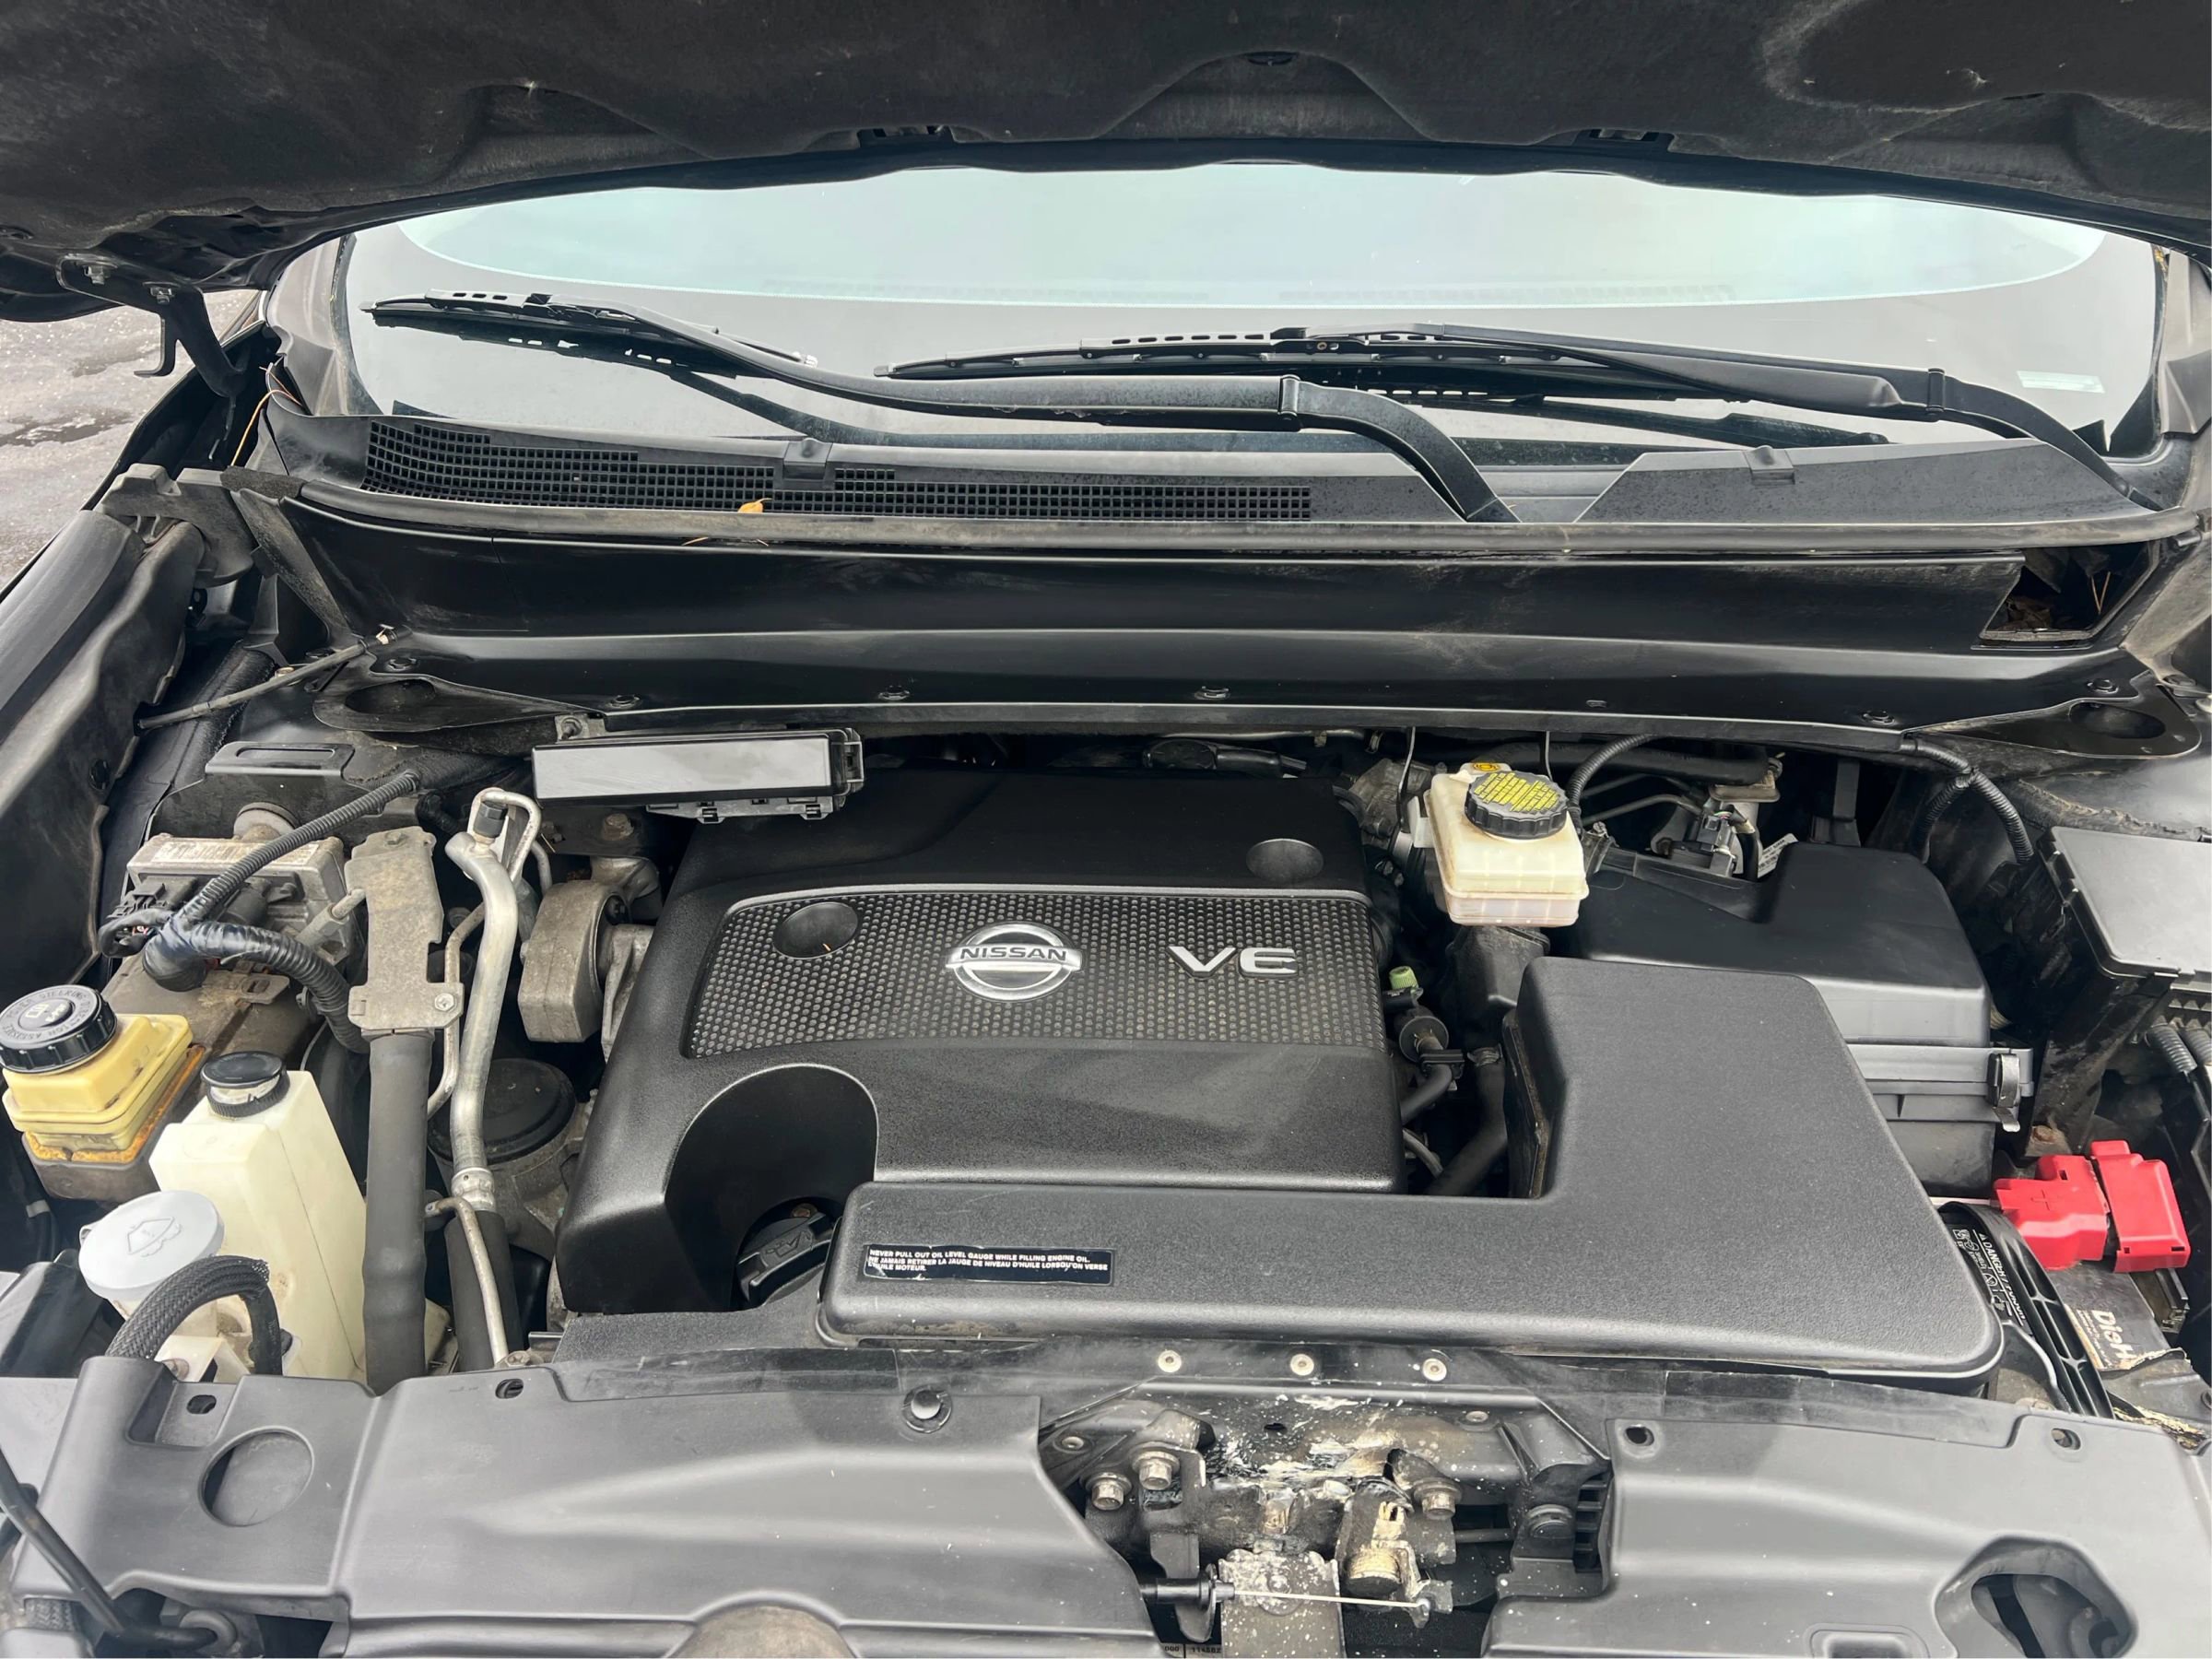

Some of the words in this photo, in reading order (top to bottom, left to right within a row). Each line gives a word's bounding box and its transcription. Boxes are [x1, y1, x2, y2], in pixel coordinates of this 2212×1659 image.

[960, 946, 1067, 962] NISSAN
[1168, 946, 1300, 979] V6
[868, 1255, 879, 1264] NE
[938, 1257, 947, 1265] LA
[1085, 1263, 1109, 1271] VERSE
[869, 1249, 894, 1257] NEVER
[968, 1252, 994, 1260] GAUGE
[1076, 1255, 1090, 1264] OIL.
[1983, 1241, 2006, 1278] DANGER
